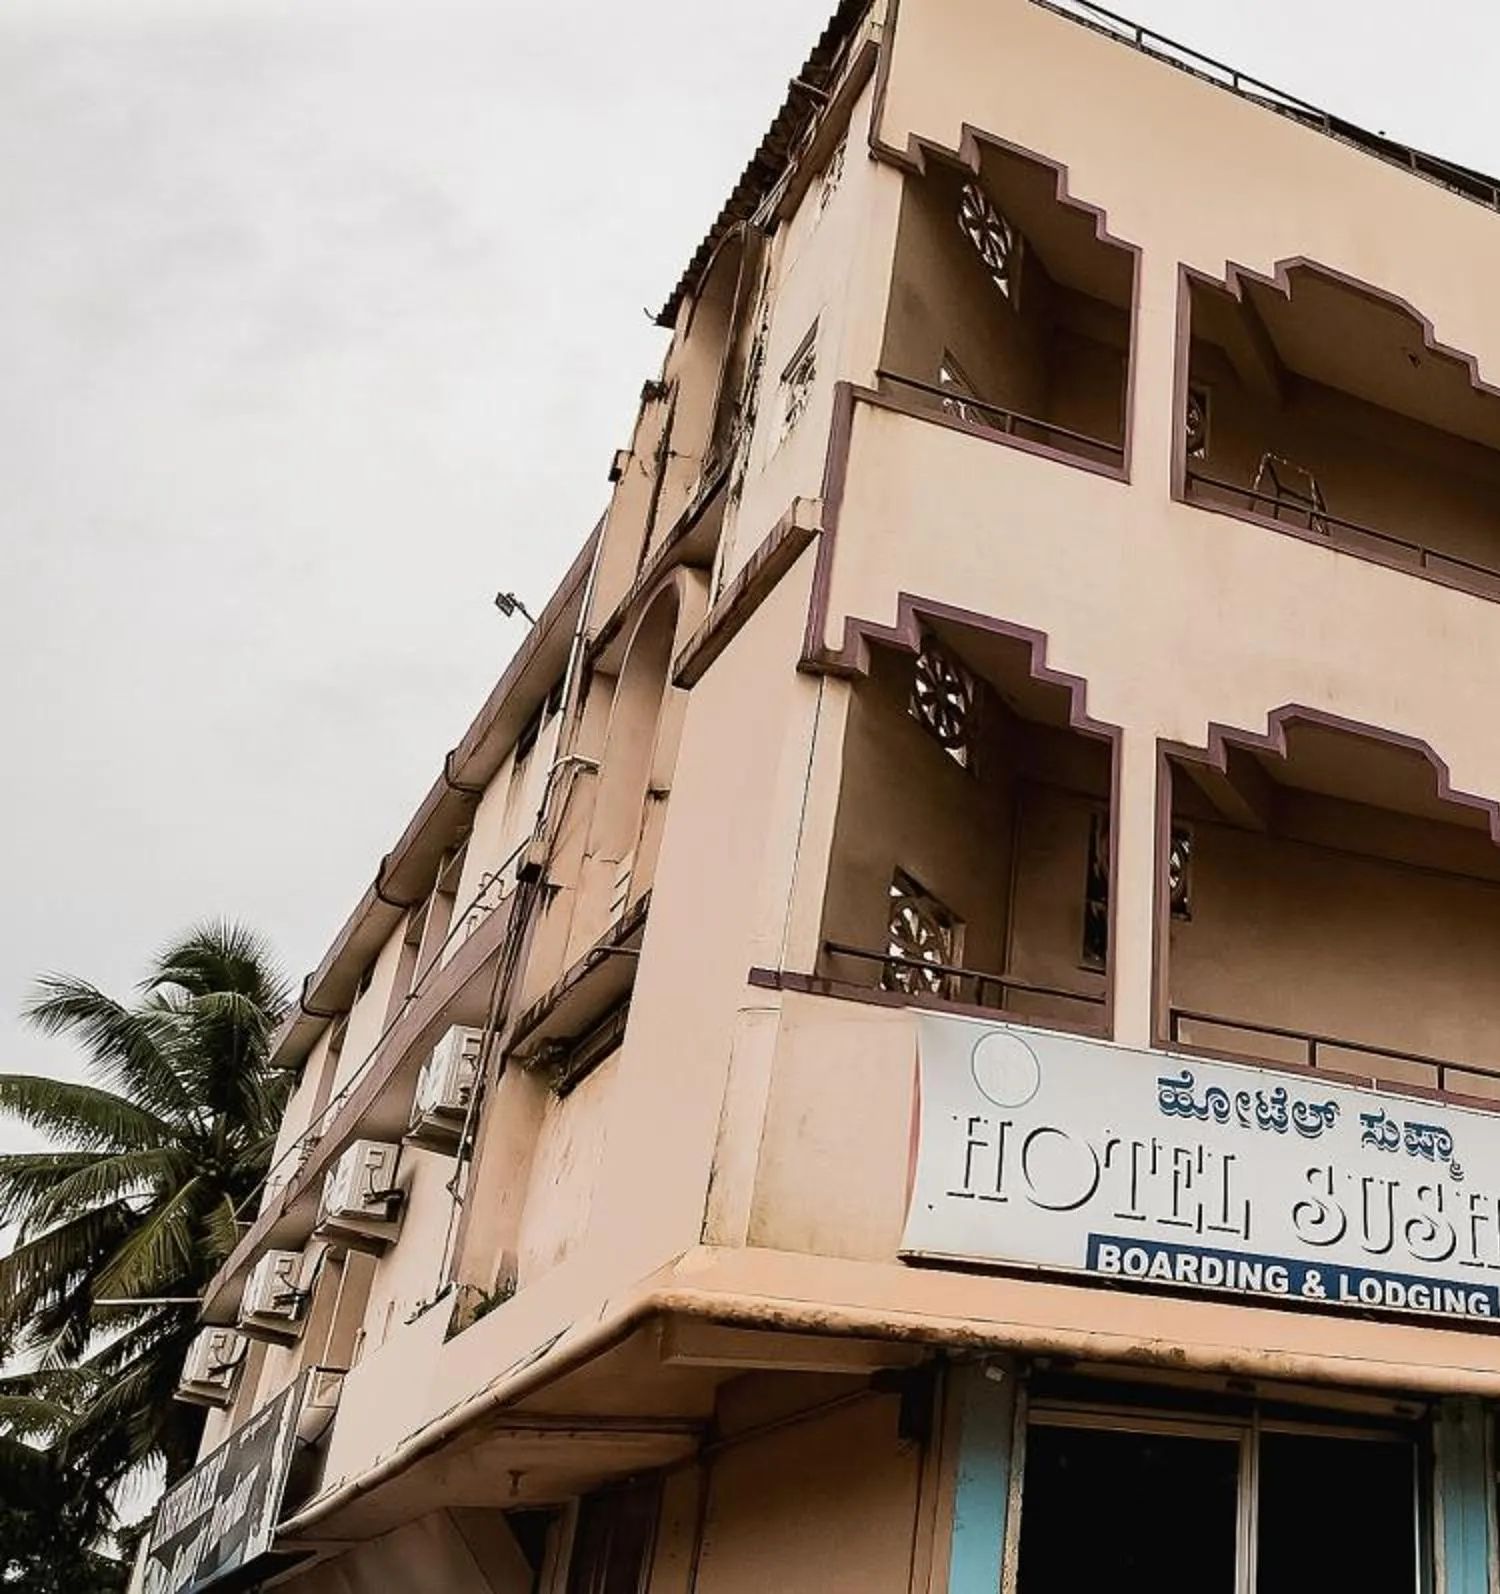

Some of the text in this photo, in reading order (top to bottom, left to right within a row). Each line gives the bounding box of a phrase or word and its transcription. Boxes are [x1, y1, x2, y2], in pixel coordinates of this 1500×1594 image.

[945, 1114, 1251, 1241] HOTEL
[1157, 1070, 1464, 1181] ಹೋಟೆಲ್ ಸುಷ್ಮಾ
[1097, 1243, 1492, 1317] BOARDING & LODGING
